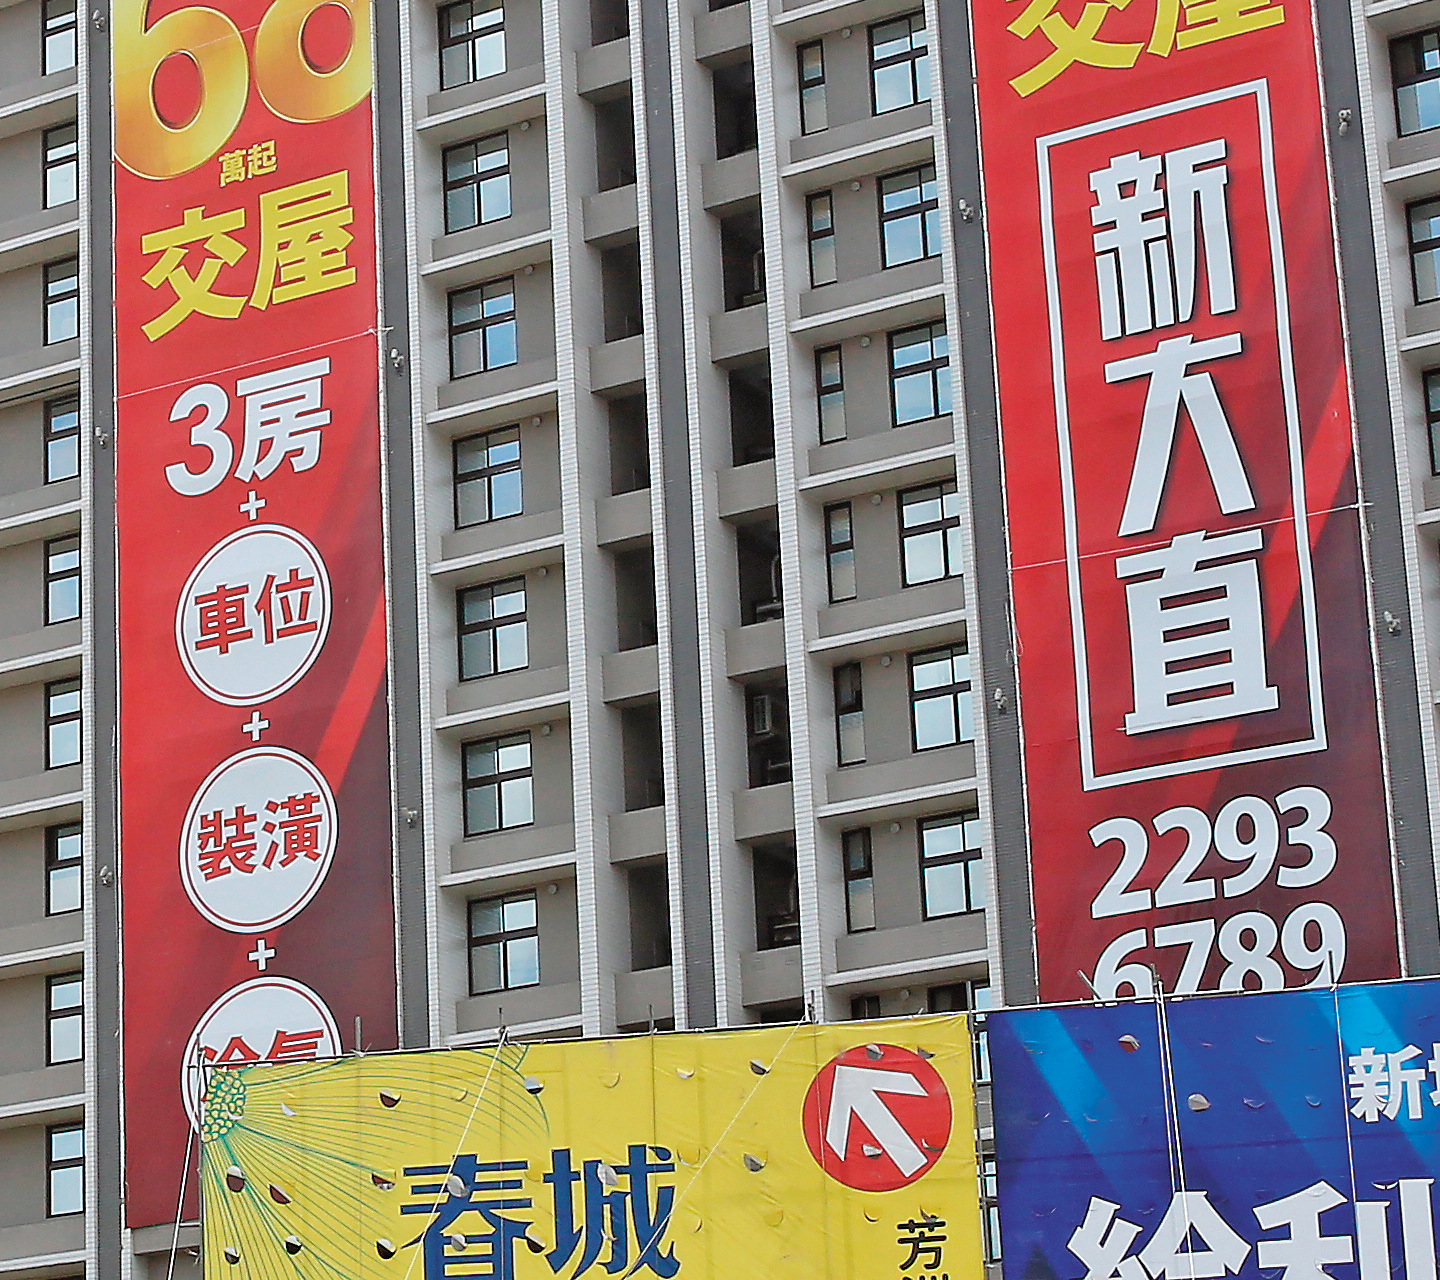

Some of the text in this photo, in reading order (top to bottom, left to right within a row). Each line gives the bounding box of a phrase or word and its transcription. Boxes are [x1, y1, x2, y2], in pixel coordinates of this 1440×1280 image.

[218, 140, 277, 182] 萬起
[141, 169, 357, 342] 交屋
[165, 358, 332, 496] 3房
[1087, 138, 1280, 736] 新大直
[193, 567, 317, 658] 車位
[198, 792, 324, 878] 裝潢
[1090, 785, 1339, 920] 2293
[1092, 900, 1348, 999] 6789
